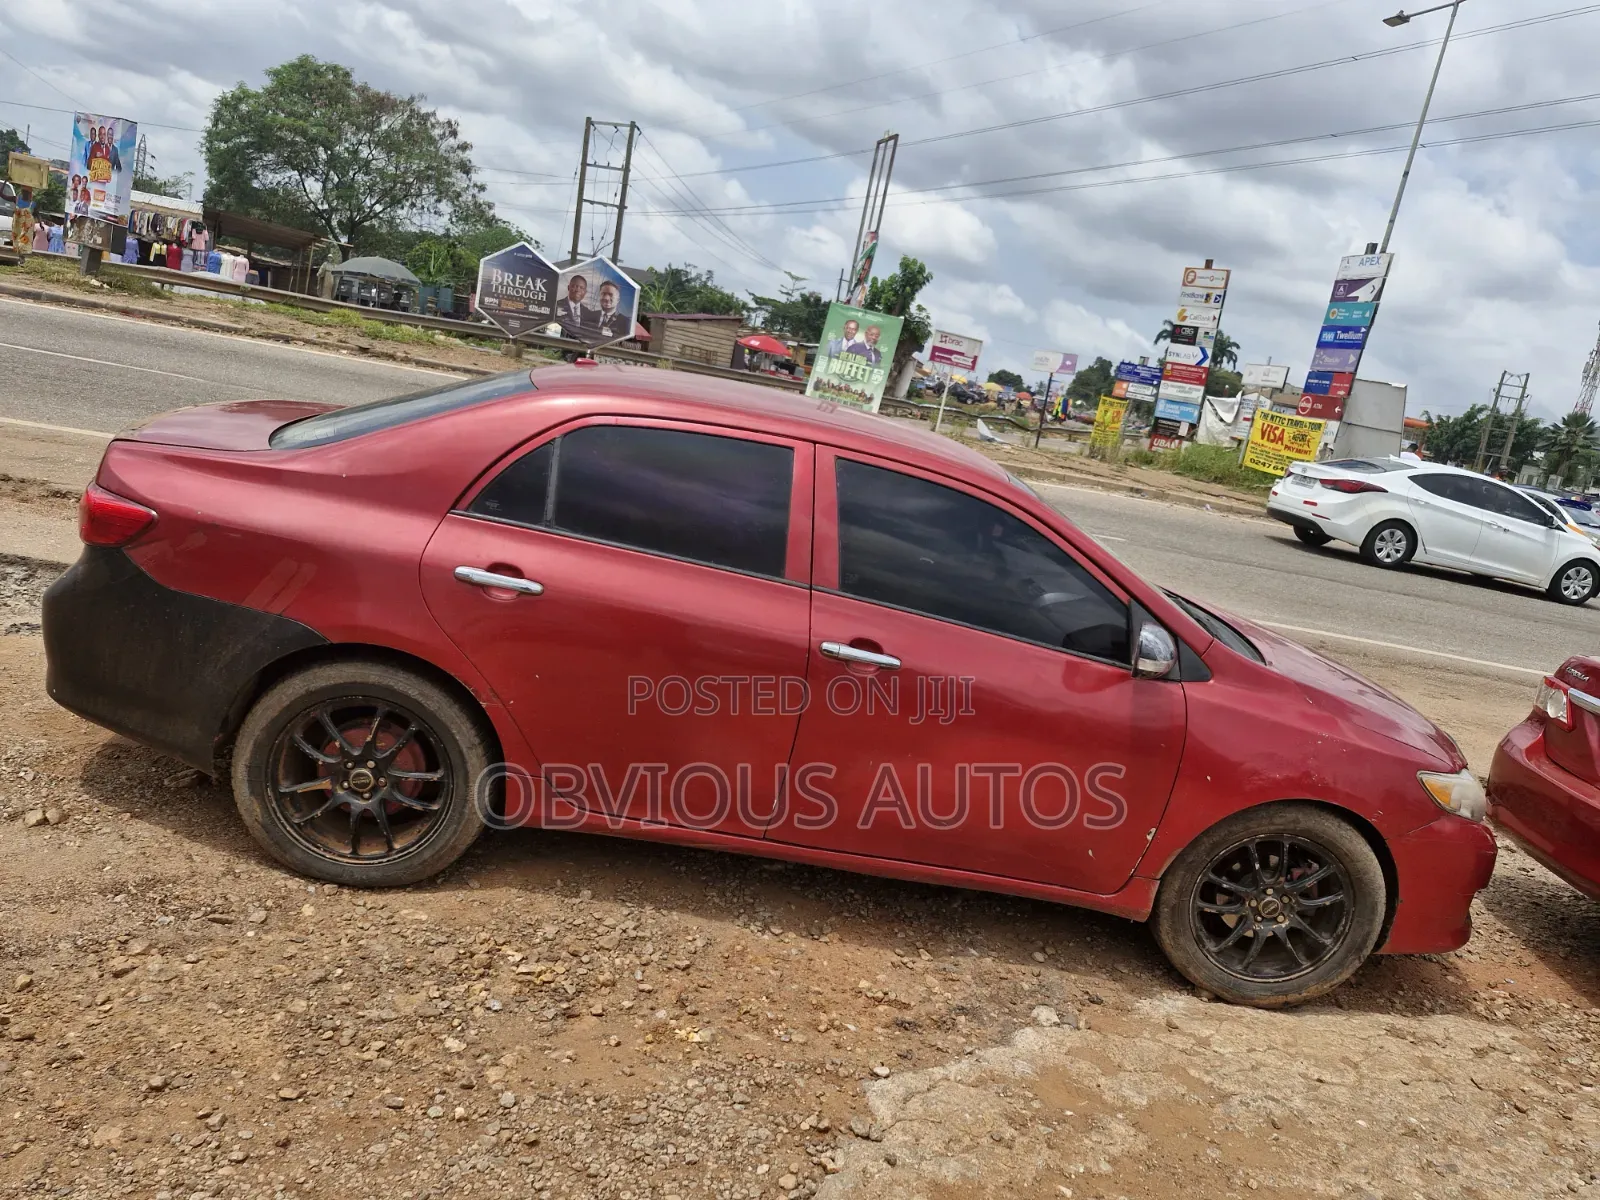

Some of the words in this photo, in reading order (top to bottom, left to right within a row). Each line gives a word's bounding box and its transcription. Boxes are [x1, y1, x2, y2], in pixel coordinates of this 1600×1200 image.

[1358, 256, 1381, 266] APEX
[491, 268, 548, 292] BREAK
[492, 283, 547, 301] THROUGH
[1180, 291, 1205, 299] FirstBank
[1189, 313, 1211, 321] CalBank
[1336, 331, 1363, 340] Twellium
[948, 337, 963, 346] brac
[1168, 350, 1192, 360] SYNLAB
[828, 357, 873, 383] BUFFET
[1259, 411, 1270, 422] THE
[1260, 422, 1286, 446] VISA
[1152, 438, 1172, 449] UBA
[1283, 445, 1313, 456] PAYMENT
[1249, 457, 1272, 469] 0247
[1566, 667, 1590, 681] COROLLA
